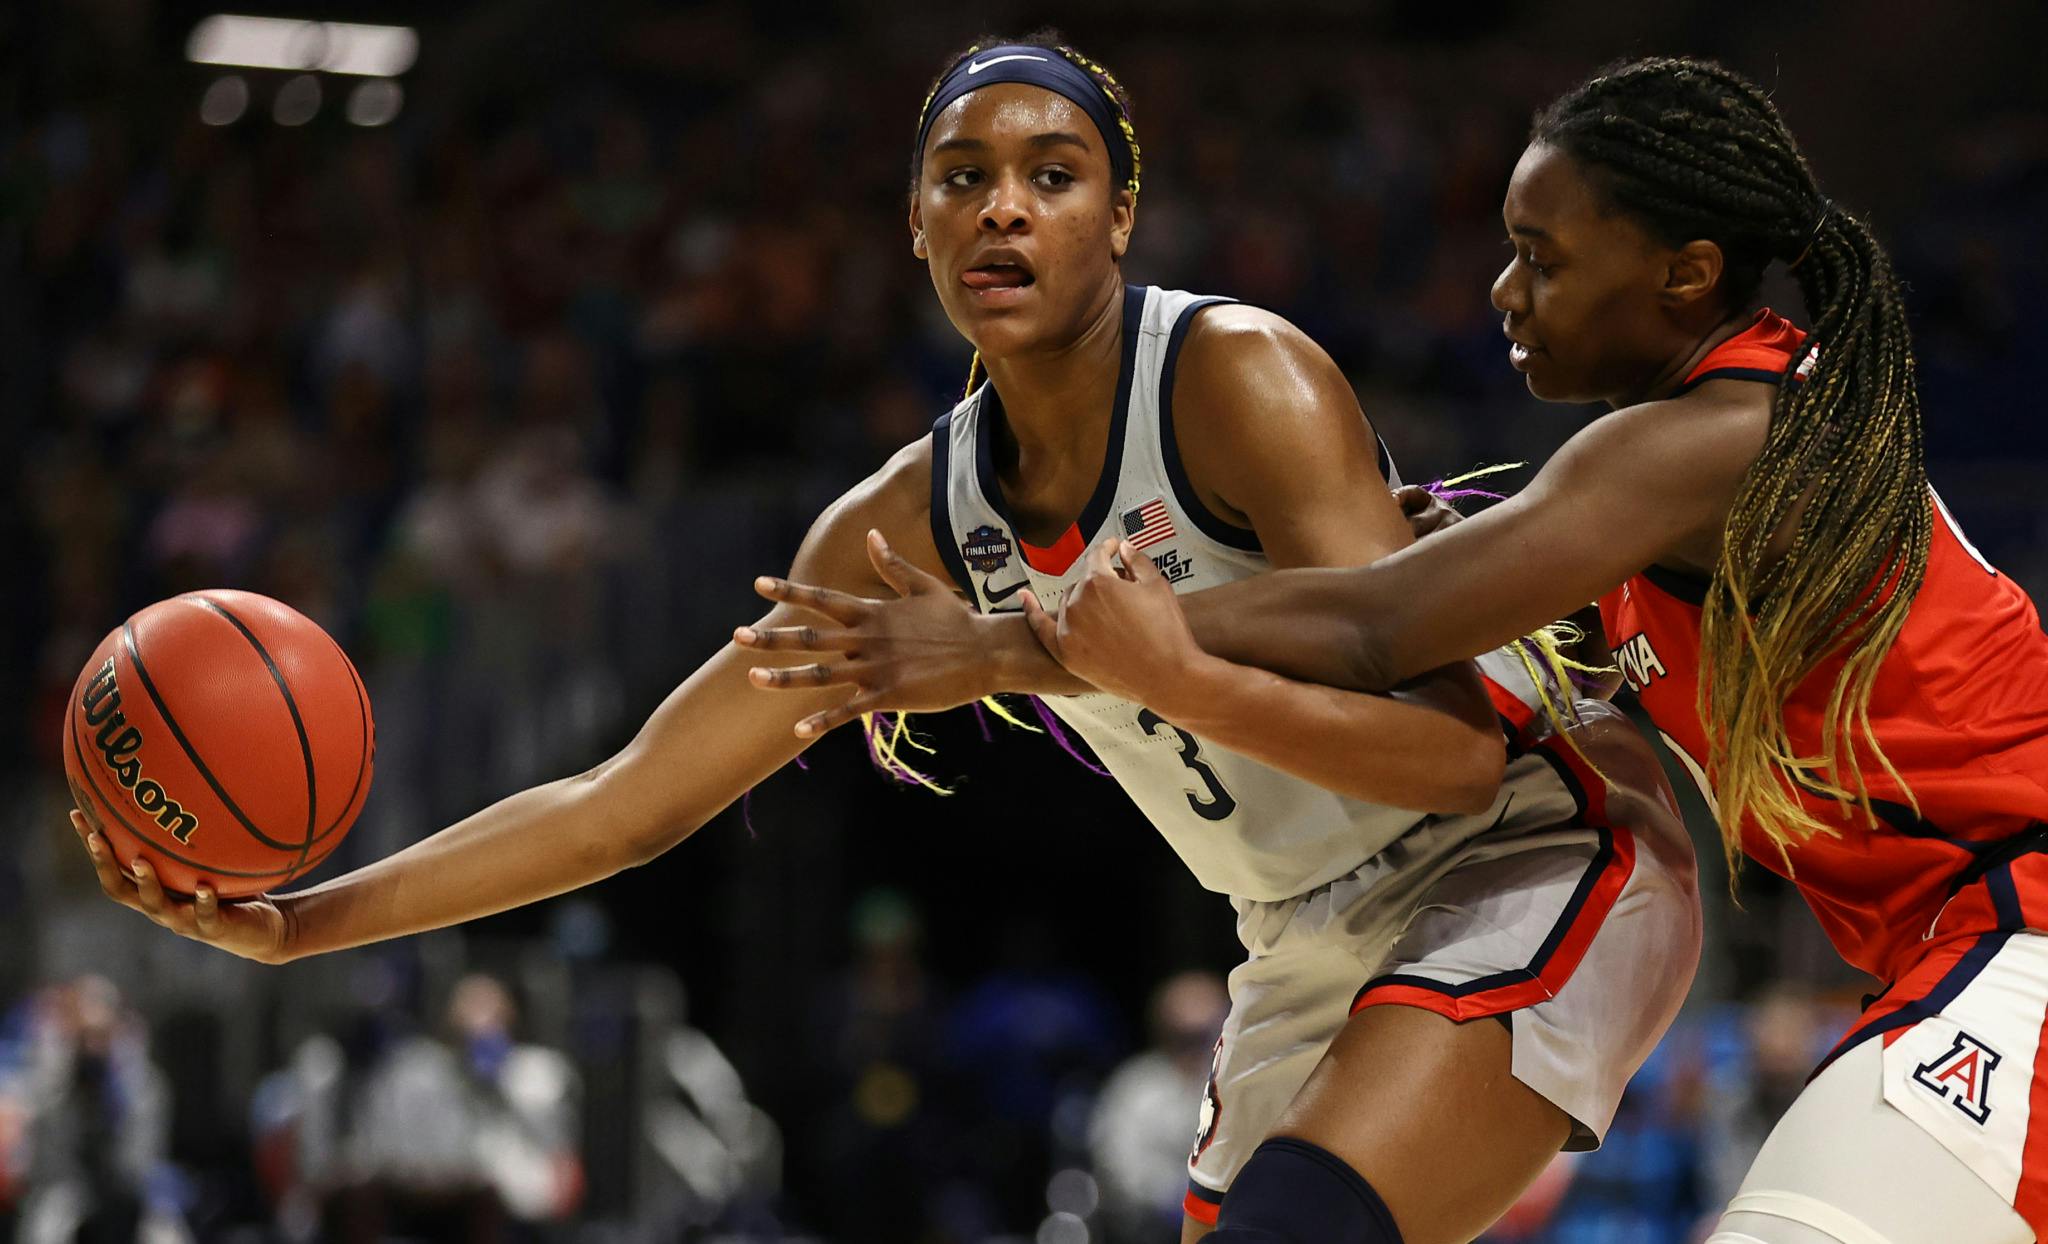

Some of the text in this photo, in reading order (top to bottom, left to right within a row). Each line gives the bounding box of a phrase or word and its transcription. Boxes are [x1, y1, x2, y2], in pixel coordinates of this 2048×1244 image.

[965, 543, 1008, 557] FINAL FOUR
[82, 656, 199, 846] Wilson
[1137, 708, 1237, 821] 3
[1912, 1030, 2003, 1127] A
